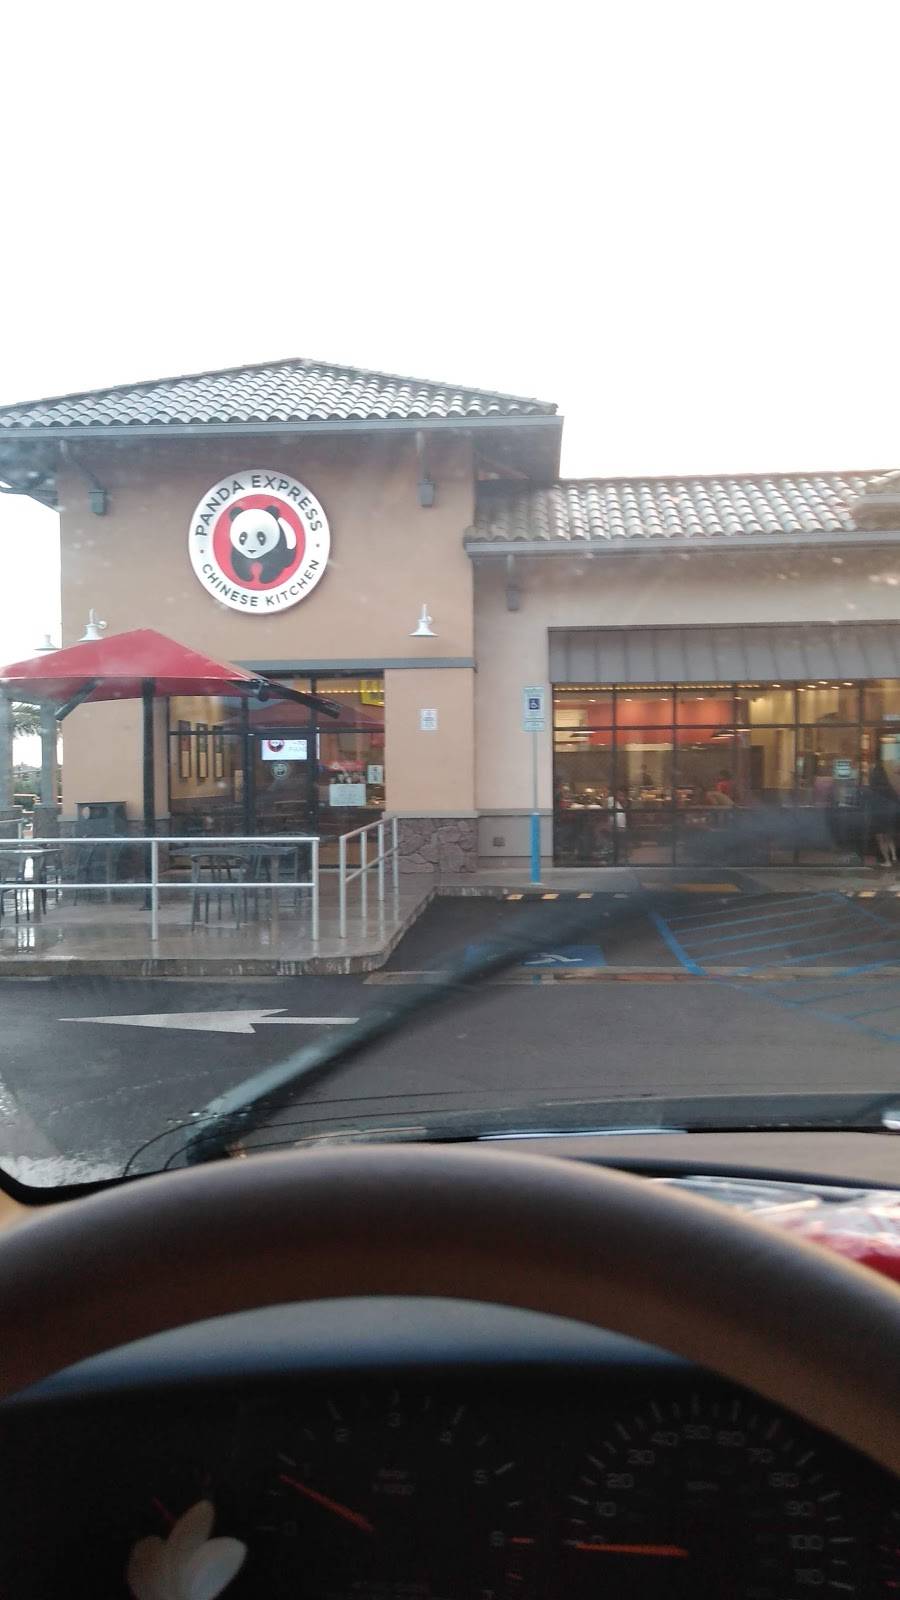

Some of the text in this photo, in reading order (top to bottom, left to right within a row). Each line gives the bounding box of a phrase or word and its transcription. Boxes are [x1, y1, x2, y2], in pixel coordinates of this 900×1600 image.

[195, 475, 323, 536] PANDA EXPRESS
[202, 560, 320, 607] CHINESE KITCHEN
[606, 1472, 635, 1488] 20
[784, 1500, 816, 1517] 90
